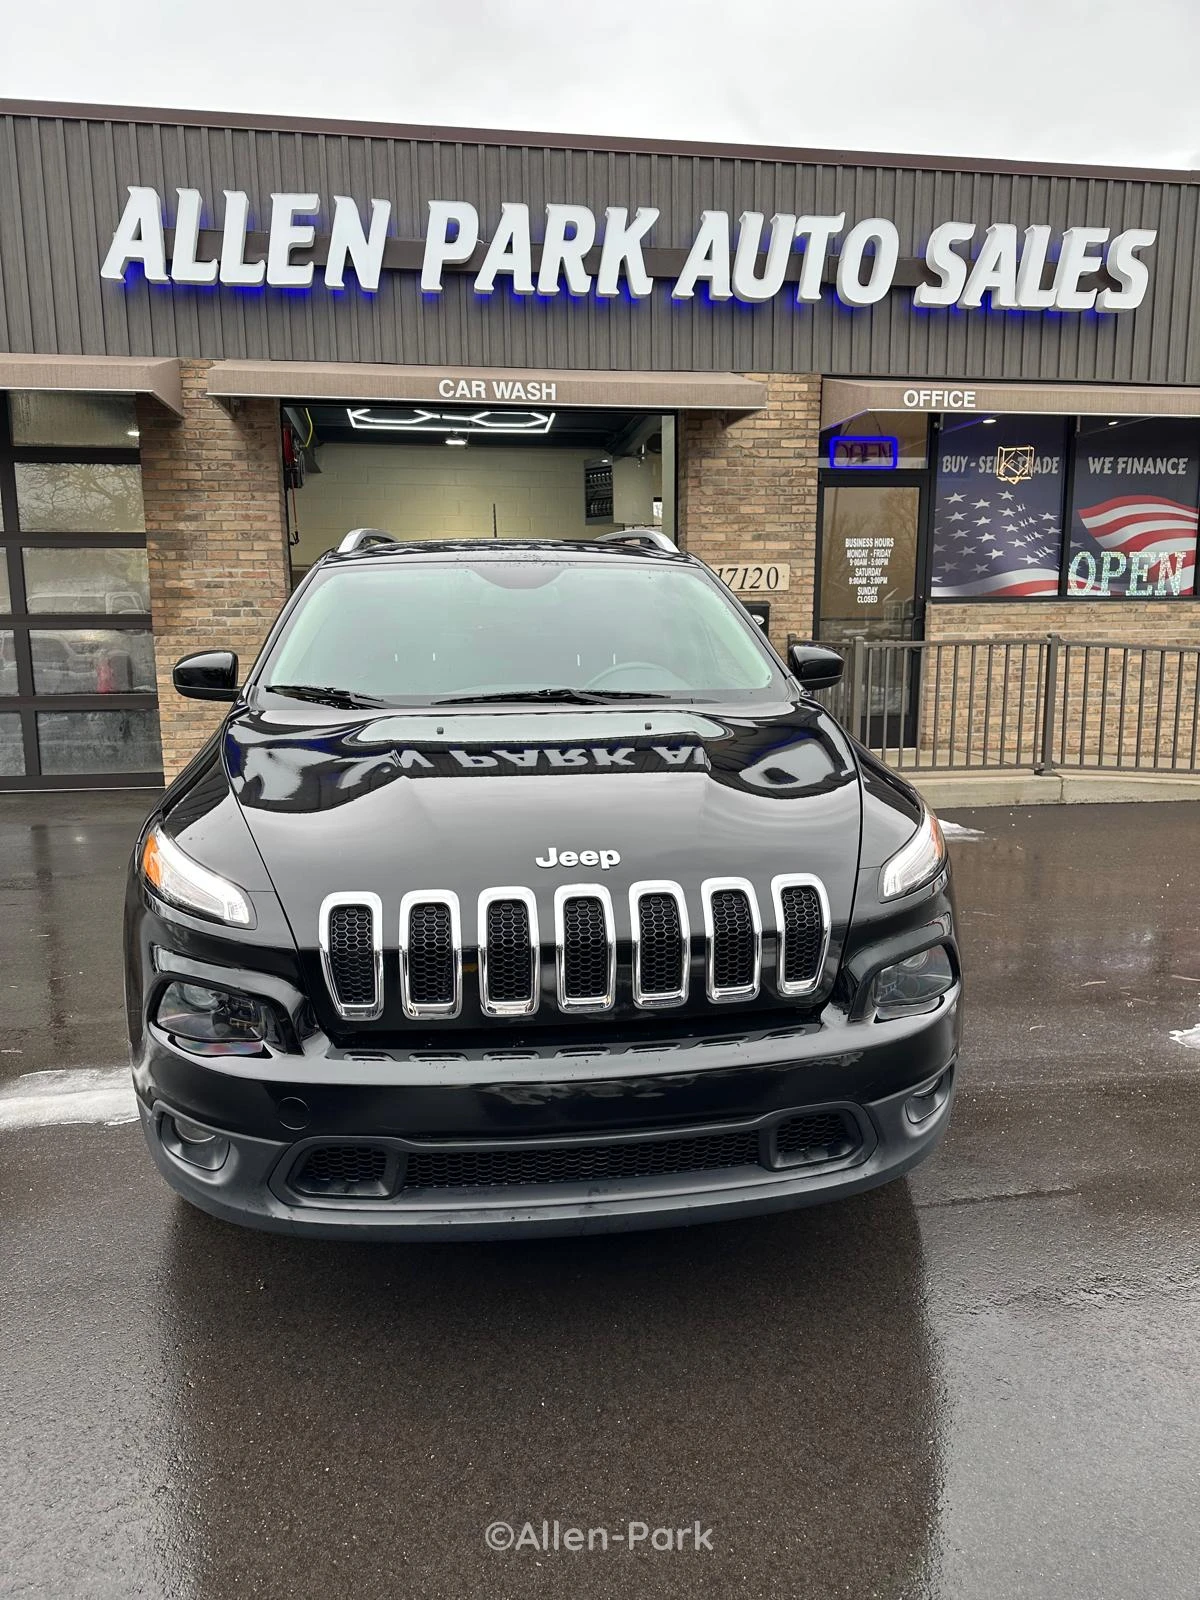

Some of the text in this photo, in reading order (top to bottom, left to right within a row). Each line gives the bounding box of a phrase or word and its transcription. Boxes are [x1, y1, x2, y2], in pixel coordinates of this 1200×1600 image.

[101, 185, 1157, 313] ALLEN PARK AUTO SALES
[439, 380, 556, 400] CAR WASH
[903, 389, 976, 407] OFFICE
[942, 455, 968, 473] BUY
[1088, 456, 1188, 475] WE FINANCE
[845, 537, 894, 548] BUSINESS HOURS
[846, 549, 868, 558] MONDAY
[873, 549, 892, 558] FRIDAY
[855, 567, 882, 577] SATURDAY
[1067, 551, 1186, 596] OPEN
[856, 595, 878, 604] CLOSED
[857, 586, 878, 596] SUNDAY
[535, 847, 621, 871] Jeep
